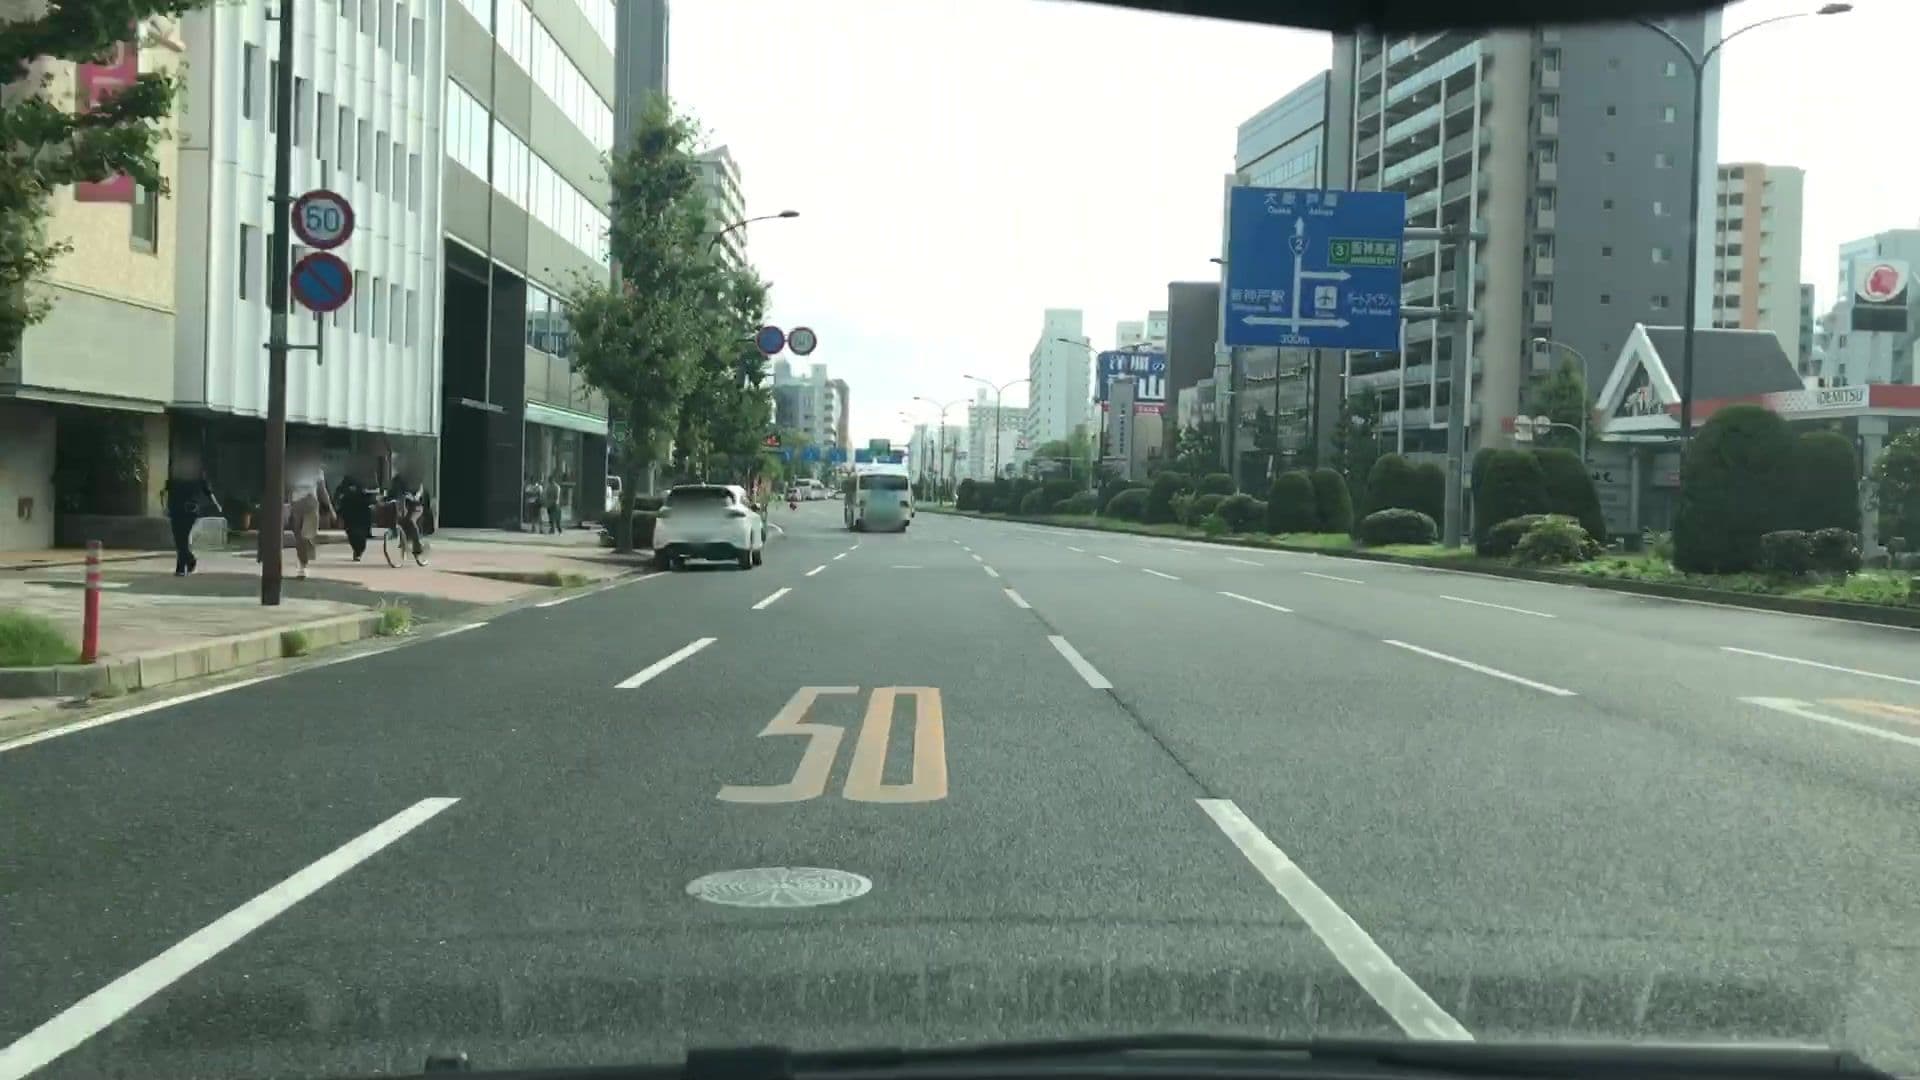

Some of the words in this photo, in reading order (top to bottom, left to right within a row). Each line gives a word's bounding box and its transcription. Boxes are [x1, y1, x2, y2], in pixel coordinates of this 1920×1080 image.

[1295, 239, 1304, 250] 2
[1335, 245, 1344, 256] 3
[716, 685, 948, 803] 50
